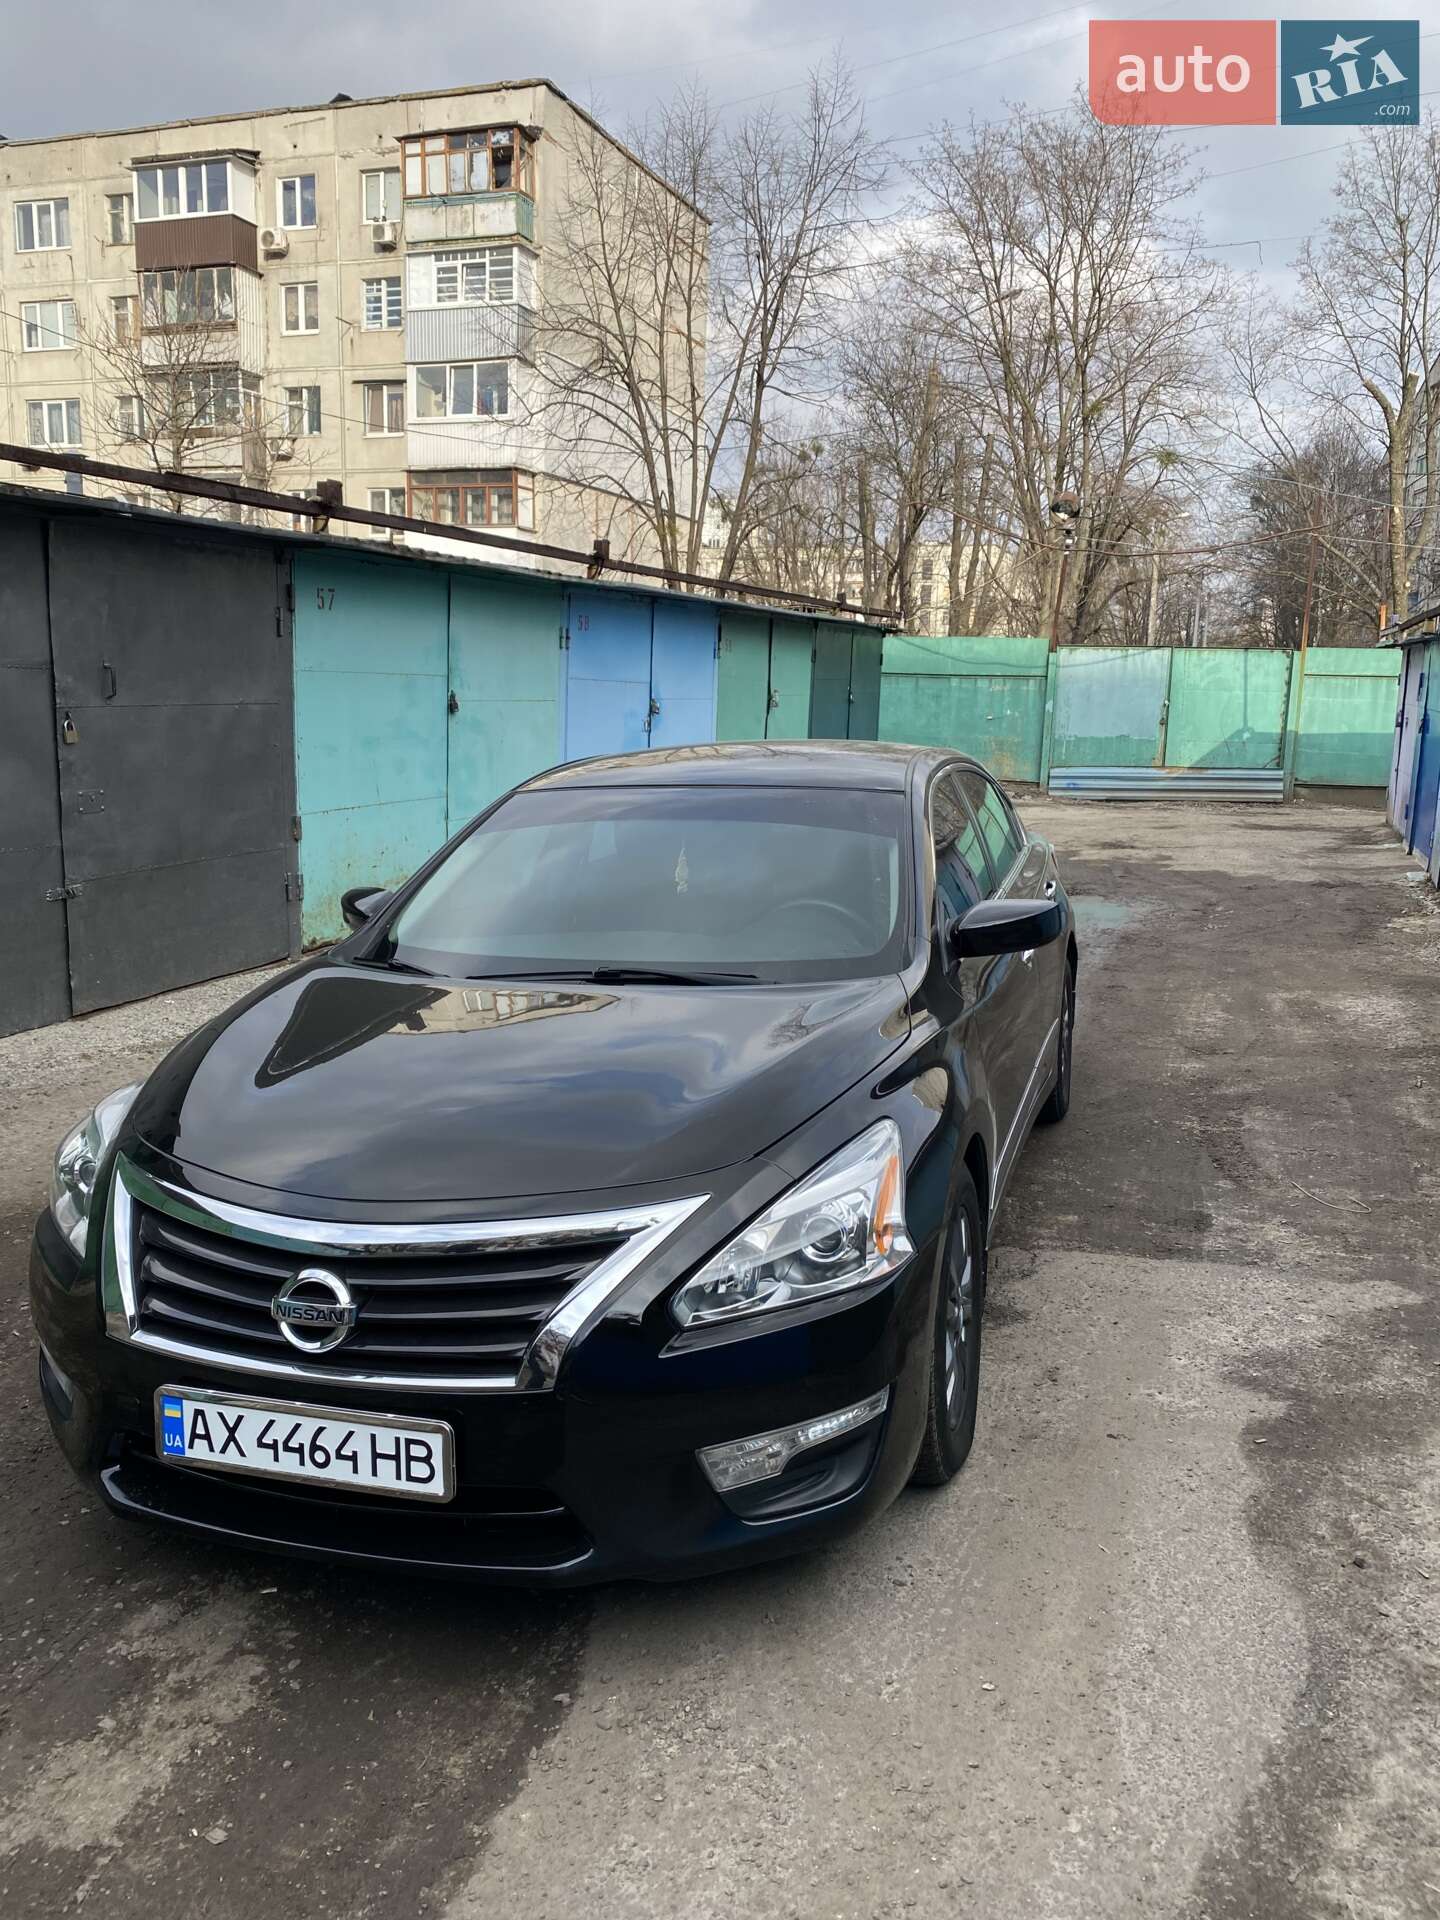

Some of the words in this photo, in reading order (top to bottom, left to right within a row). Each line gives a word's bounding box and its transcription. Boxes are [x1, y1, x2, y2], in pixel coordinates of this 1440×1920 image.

[316, 587, 336, 611] 57
[275, 1304, 344, 1325] NISSAN
[165, 1432, 183, 1448] UA
